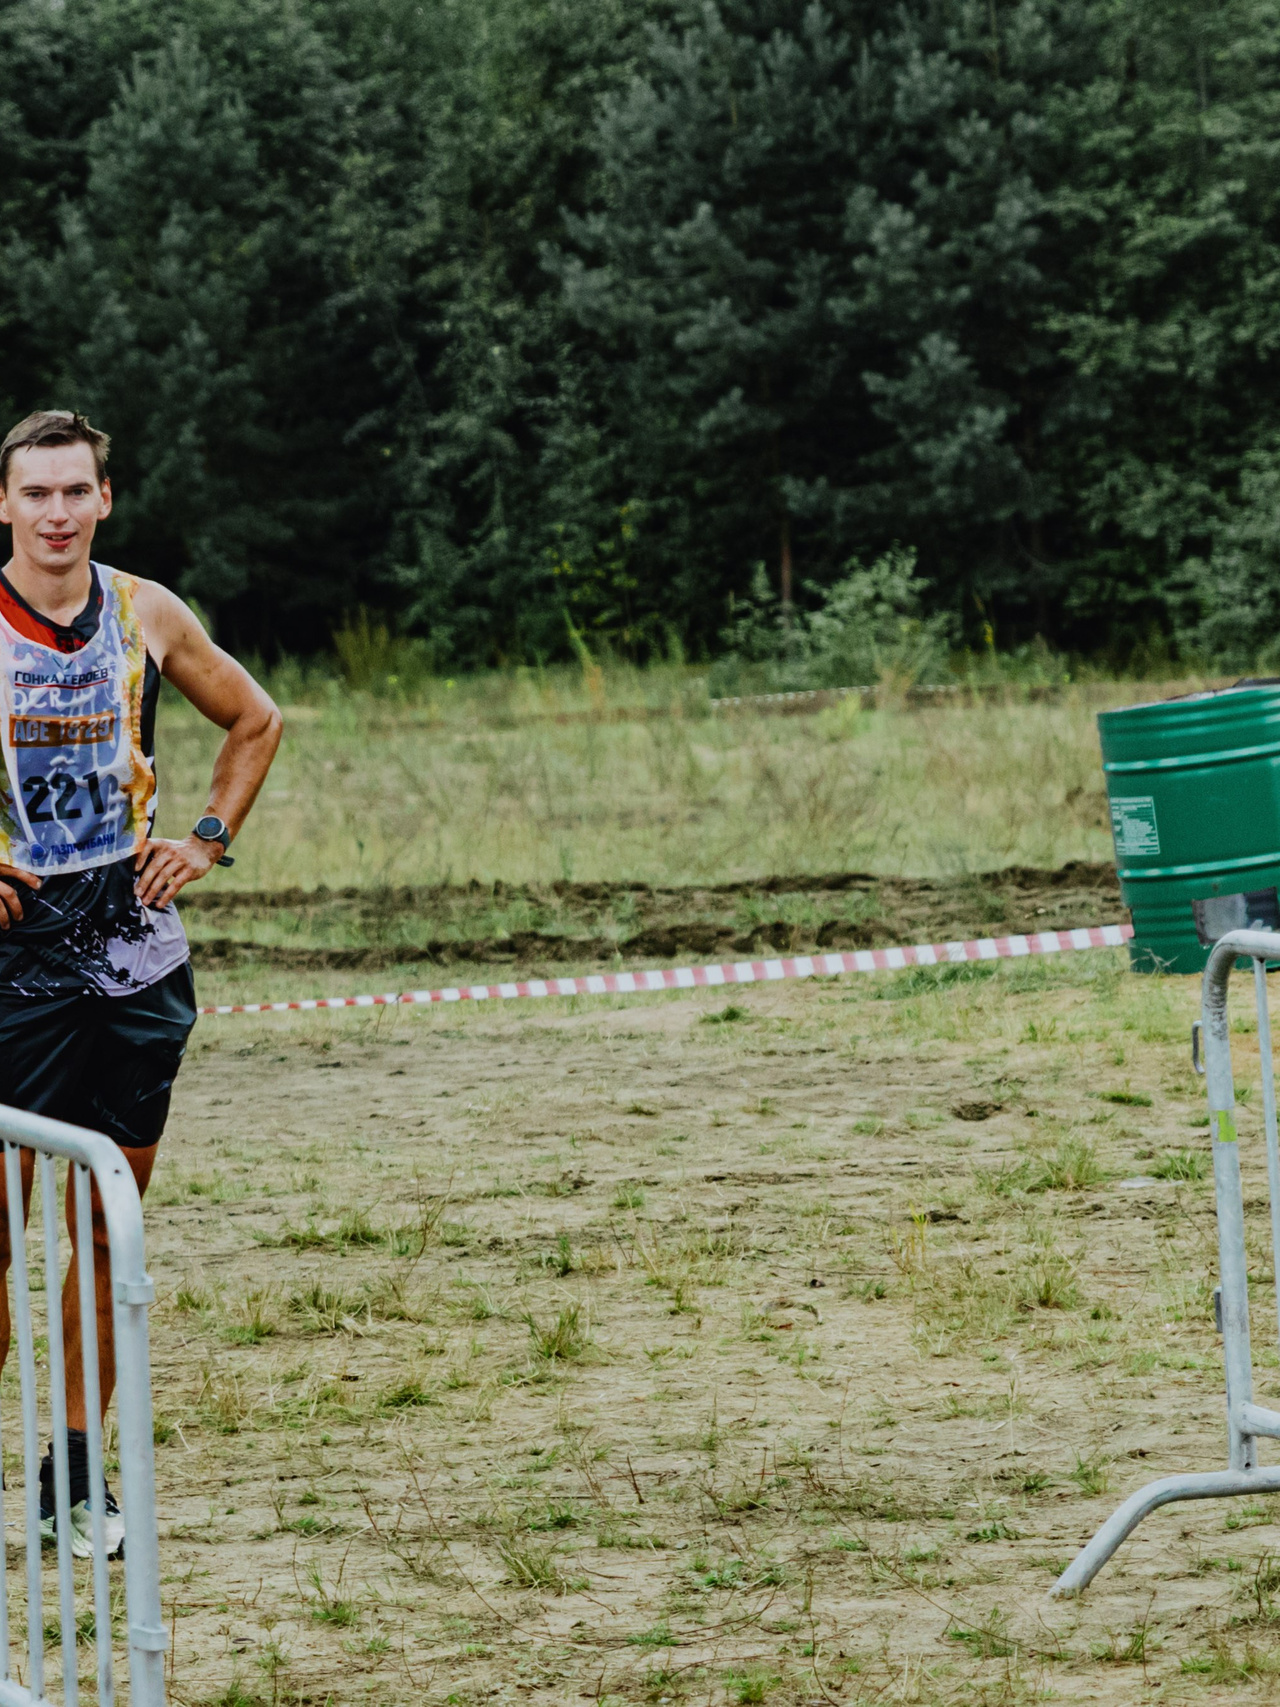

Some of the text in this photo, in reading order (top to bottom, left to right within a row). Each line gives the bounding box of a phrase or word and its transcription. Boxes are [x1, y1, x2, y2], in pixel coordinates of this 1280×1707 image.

[14, 667, 108, 685] ГОНКА ГЕРОЕВ
[13, 719, 50, 742] AGE
